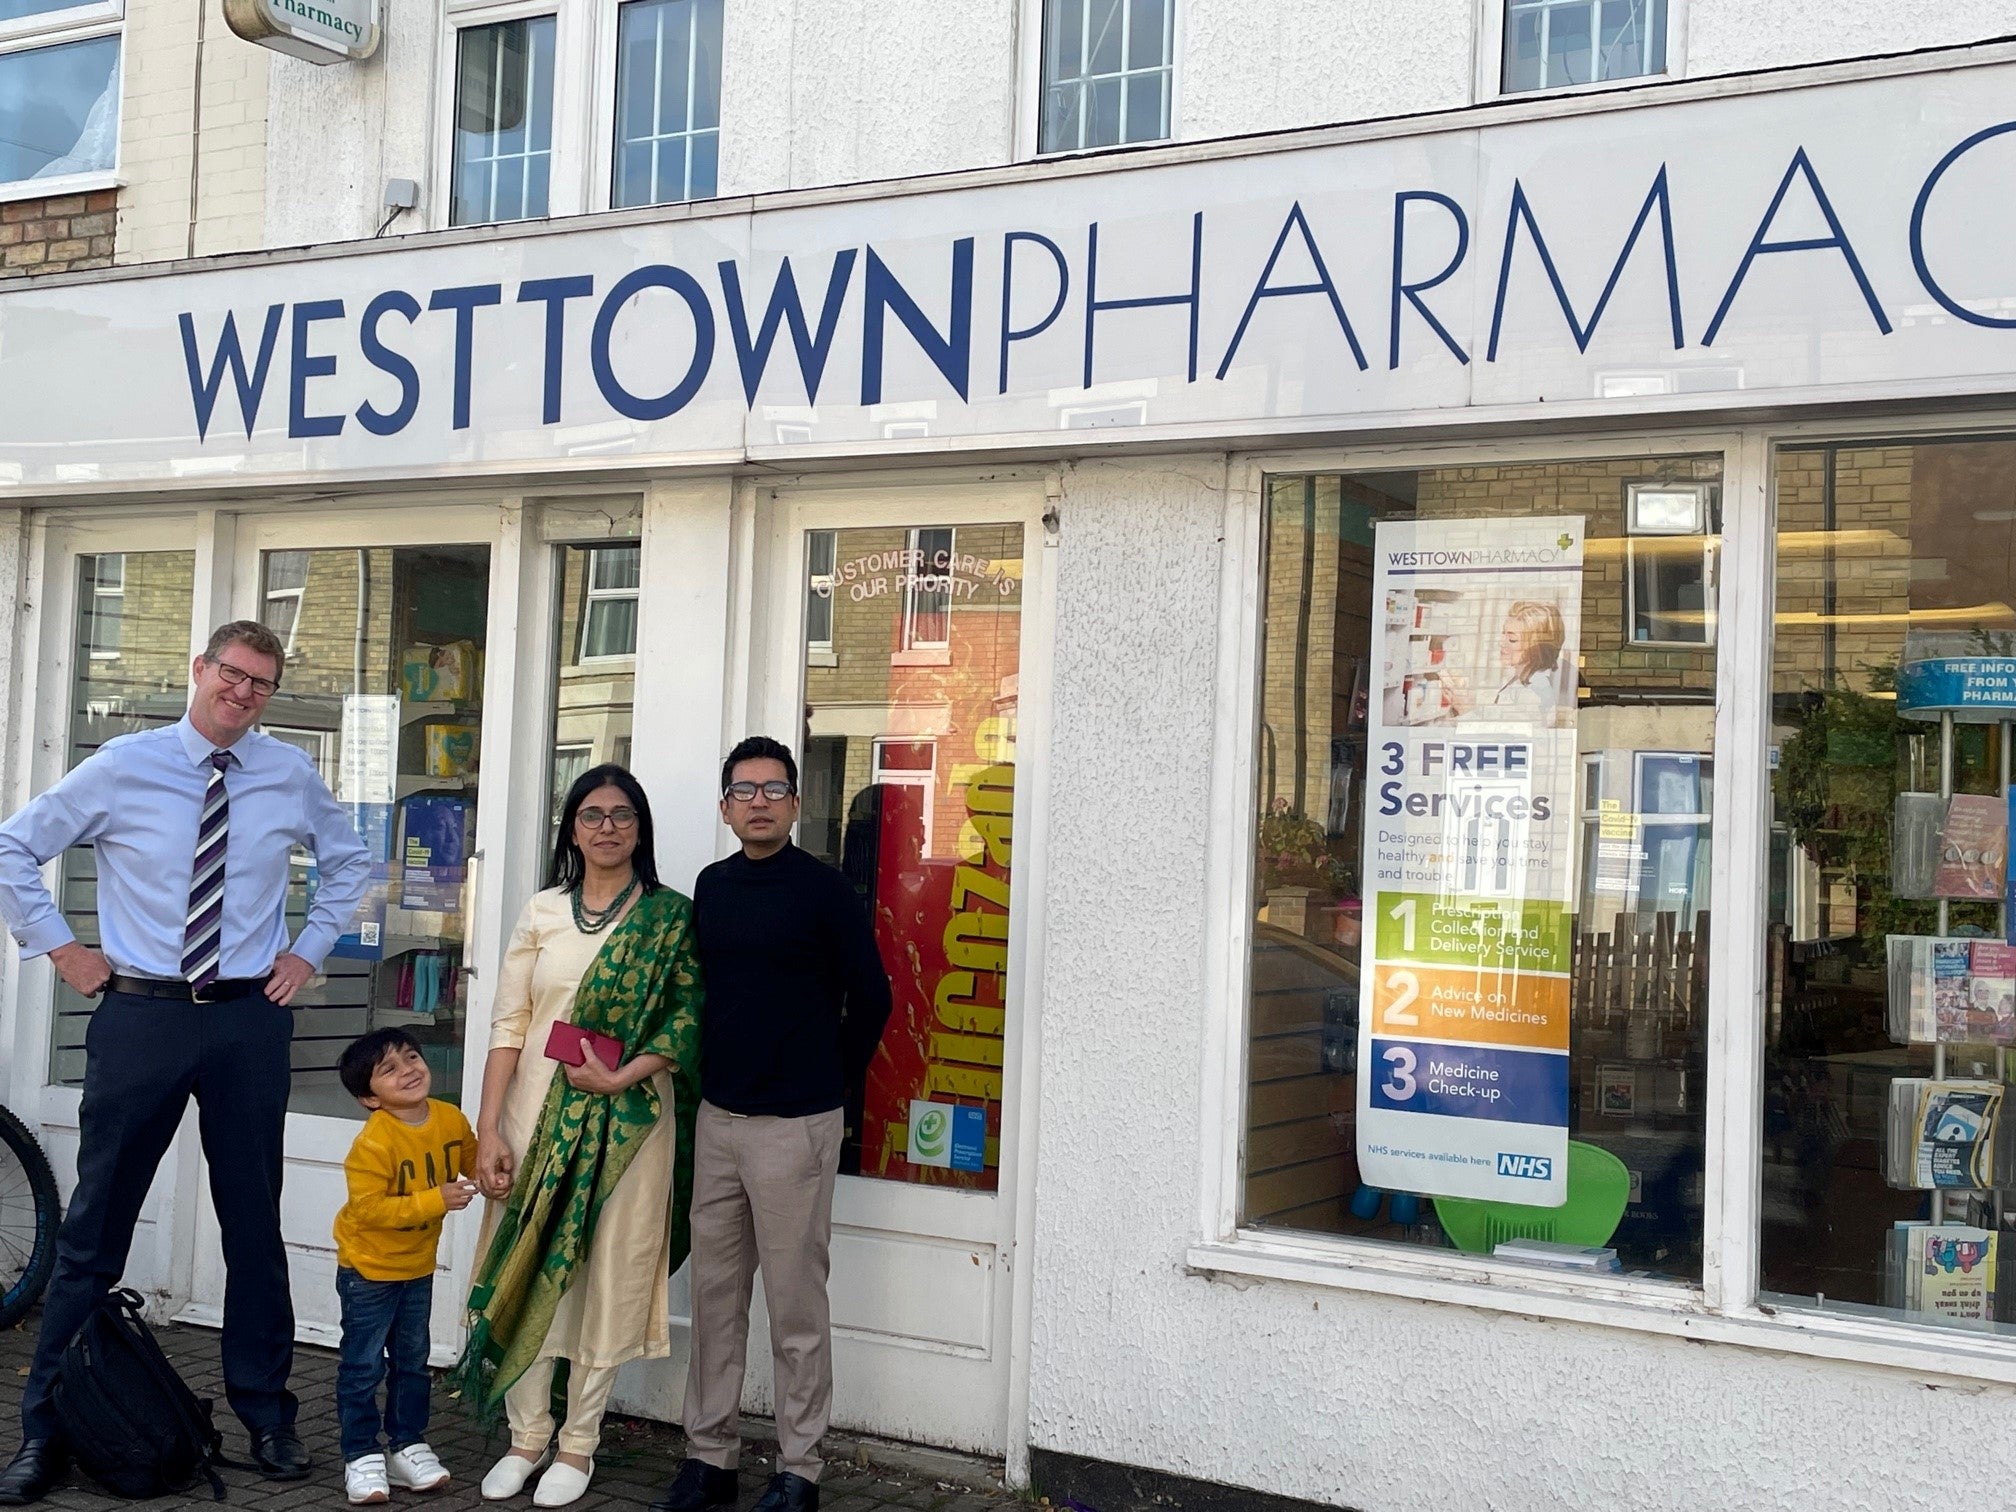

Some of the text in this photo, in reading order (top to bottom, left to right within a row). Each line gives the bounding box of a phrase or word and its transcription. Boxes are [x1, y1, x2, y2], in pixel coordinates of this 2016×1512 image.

[816, 550, 1015, 598] CUSTOMER CARE IS
[850, 574, 980, 602] OUR PRIORITY
[1944, 663, 1977, 673] FREE
[1967, 677, 2008, 687] FROM
[1963, 691, 2016, 702] PHARM
[1381, 741, 1527, 778] 3 FREE
[1379, 781, 1551, 821] Services
[1602, 800, 1618, 809] The
[1601, 814, 1638, 823] Covid-9
[1378, 830, 1441, 847] Designed
[1463, 834, 1491, 849] hep
[1522, 837, 1549, 852] stay
[1377, 850, 1425, 865] healthy
[1429, 852, 1454, 863] and
[1519, 856, 1549, 868] tme
[1377, 867, 1453, 881] and troube
[1389, 900, 1520, 951] 1 Prescription
[1511, 925, 1539, 939] and
[1431, 937, 1549, 958] Delivery Service
[1384, 970, 1507, 1026] 2 Advice on
[1431, 1003, 1548, 1025] New Medicines
[1381, 1046, 1499, 1101] 3 Medicine
[1428, 1079, 1501, 1103] Check-up
[1368, 1145, 1550, 1179] NHS services available here NHS
